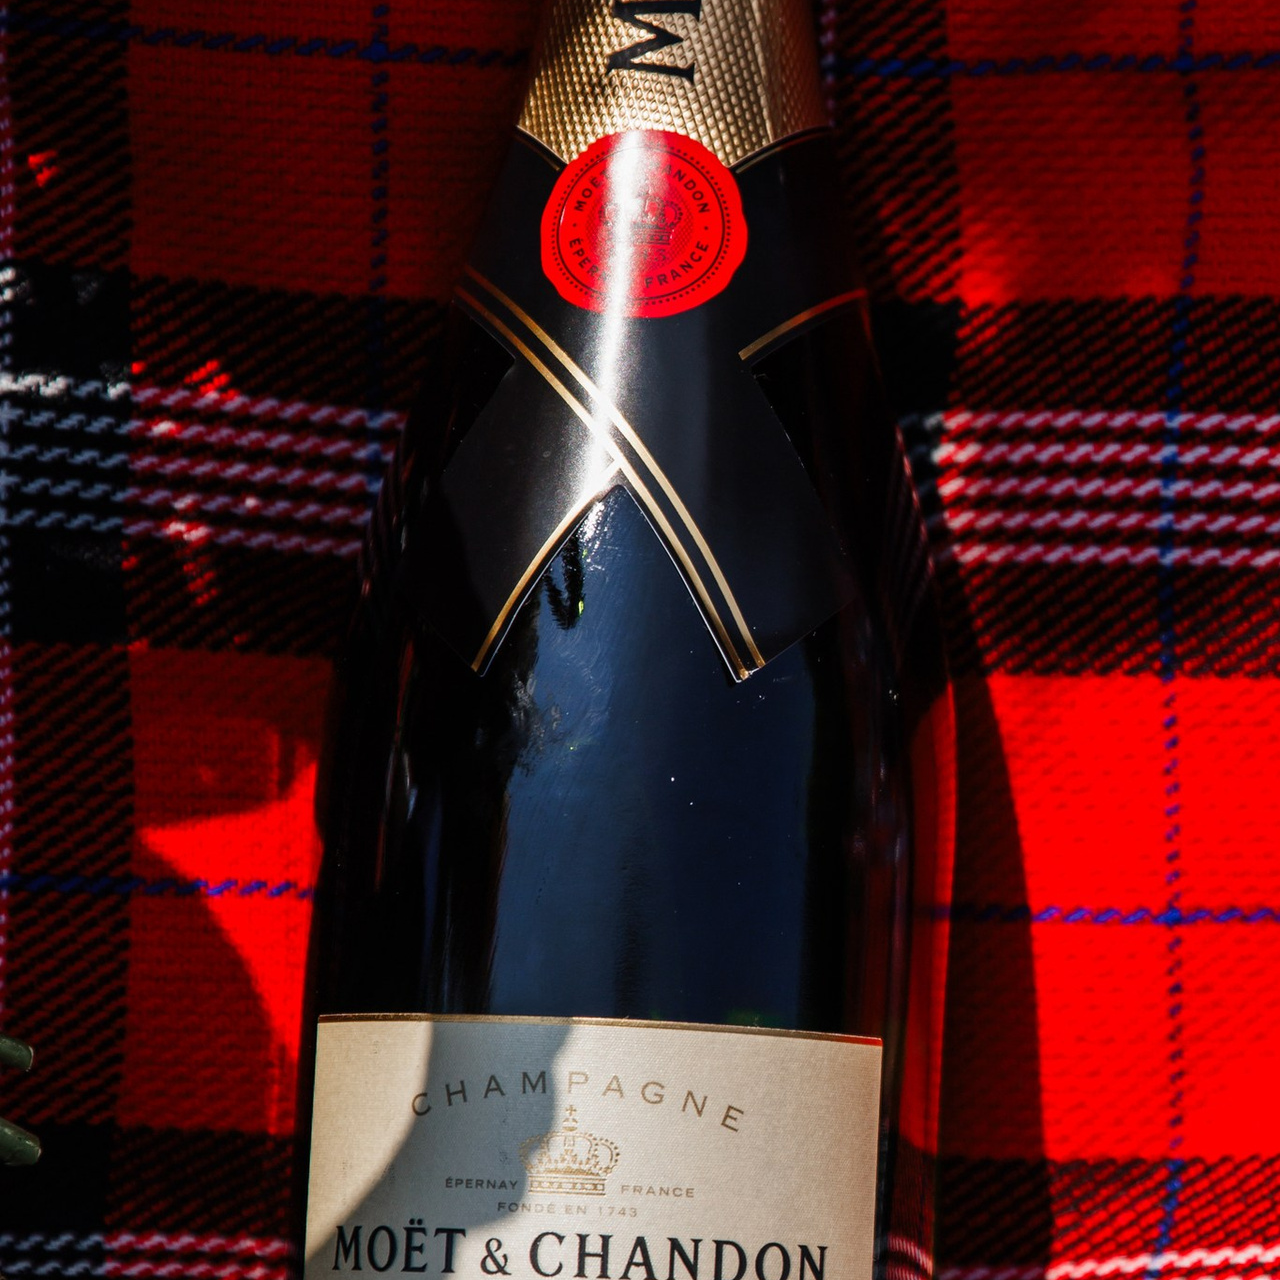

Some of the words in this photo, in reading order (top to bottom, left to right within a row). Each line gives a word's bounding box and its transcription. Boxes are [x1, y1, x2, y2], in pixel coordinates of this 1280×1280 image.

[645, 241, 709, 288] FRANCE
[411, 1071, 745, 1132] CHAMPAGNE
[445, 1175, 518, 1190] ÉPERNAY
[621, 1184, 695, 1198] FRANCE
[565, 1205, 587, 1216] EN
[600, 1206, 638, 1218] 1743
[332, 1219, 467, 1275] MOËT
[480, 1236, 513, 1278] &
